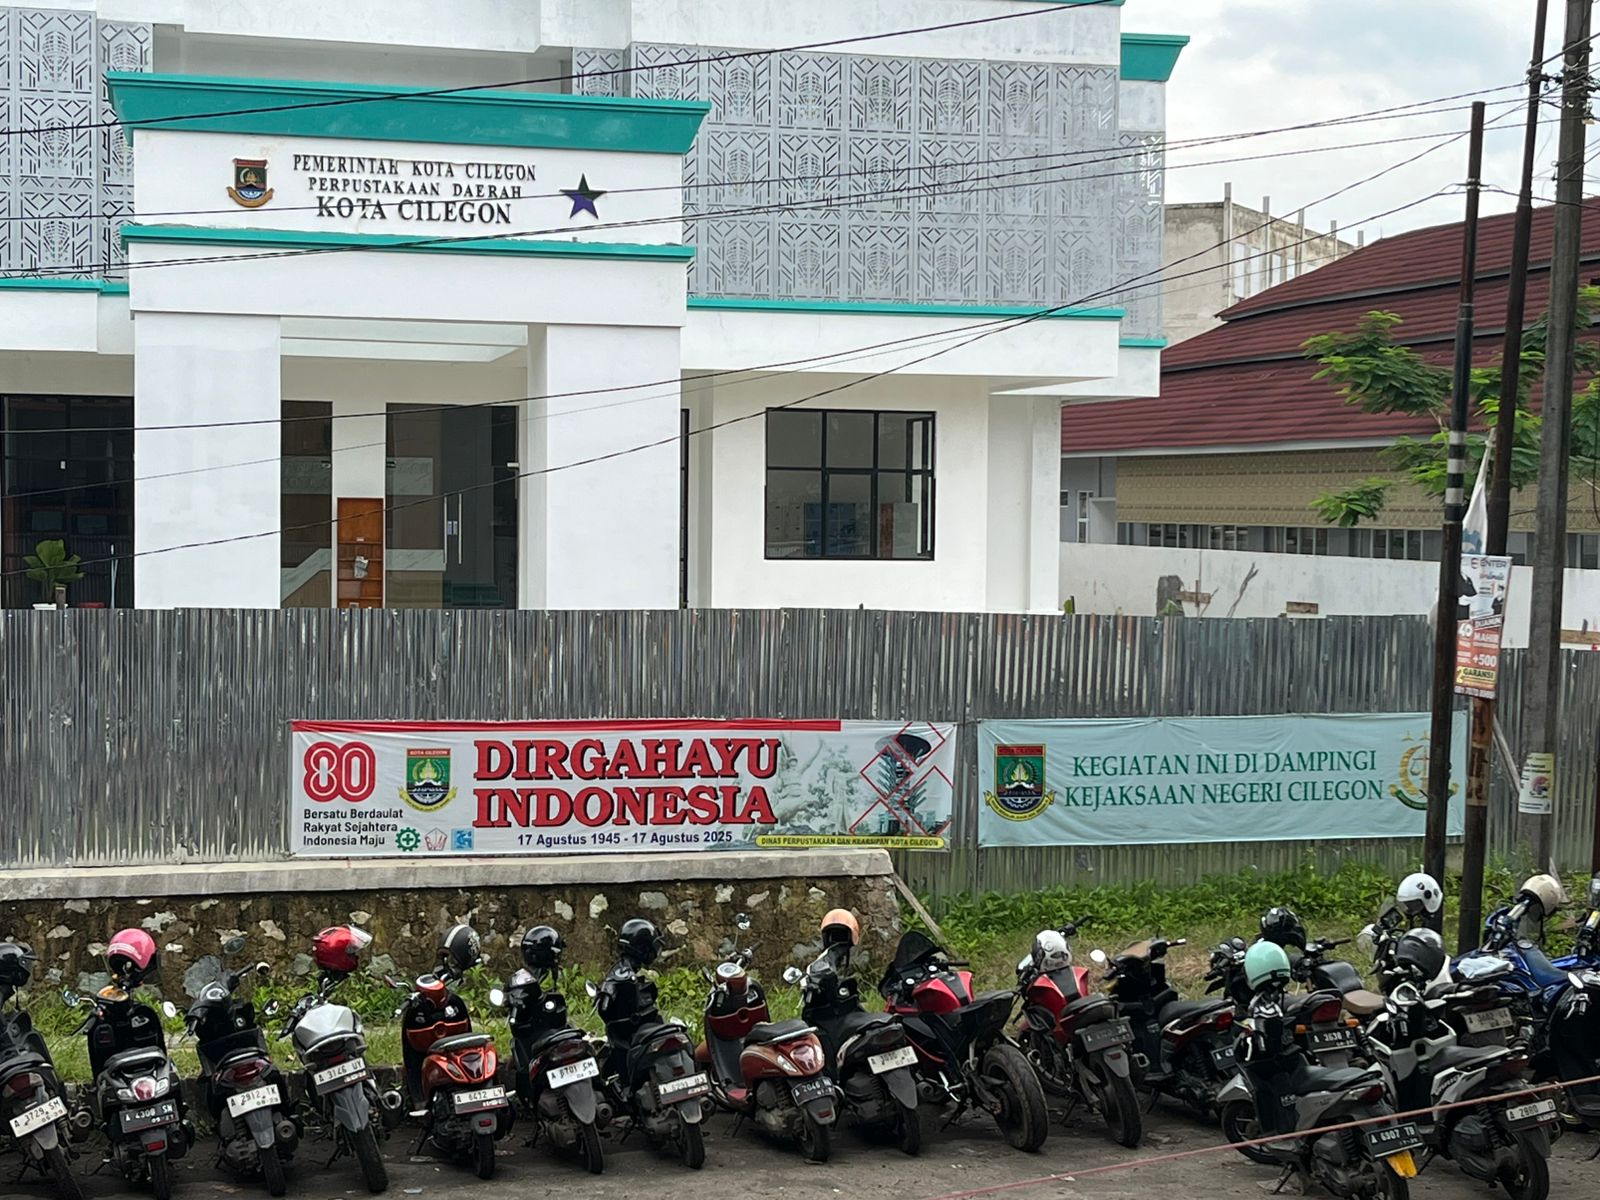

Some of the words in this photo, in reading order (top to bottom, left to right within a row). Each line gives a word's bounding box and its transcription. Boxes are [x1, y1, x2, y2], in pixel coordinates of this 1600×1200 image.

[293, 154, 399, 175] PEMERINTAH
[412, 161, 455, 178] KOTA
[465, 162, 536, 181] CILEGON
[308, 177, 440, 196] PERPUSTAKAAN
[452, 183, 522, 199] DAERAH
[316, 196, 387, 220] KOTA
[398, 199, 511, 224] CILEGON
[1463, 668, 1494, 679] GARANSI
[473, 738, 781, 781] DIRGAHAYU
[1072, 754, 1190, 777] KEGIATAN
[1196, 753, 1230, 774] INI
[1234, 753, 1258, 773] DI
[1264, 750, 1377, 772] DAMPINGI
[303, 741, 376, 803] 80
[1064, 784, 1196, 812] KEJAKSAAN
[1201, 782, 1283, 804] NEGERI
[1287, 779, 1384, 802] CILEGON
[472, 785, 778, 828] INDONESIA
[303, 808, 347, 819] Bersatu
[350, 808, 403, 819] Berdaulat
[303, 822, 342, 835] Rakyat
[344, 821, 398, 834] Sejahtera
[303, 835, 357, 846] Indonesia
[360, 834, 385, 847] Maju
[518, 834, 532, 846] 17
[536, 834, 587, 848] Agustus
[590, 833, 620, 844] 1945
[632, 832, 646, 843] 17
[650, 832, 700, 846] Agustus
[703, 831, 733, 843] 2025
[783, 837, 835, 845] PERPUSTAKAAN
[318, 1074, 325, 1082] A
[551, 1072, 556, 1080] A
[230, 1098, 236, 1107] A
[456, 1095, 462, 1103] A
[125, 1114, 131, 1122] A
[1509, 1110, 1516, 1119] A
[14, 1119, 20, 1128] A
[1371, 1134, 1378, 1144] A
